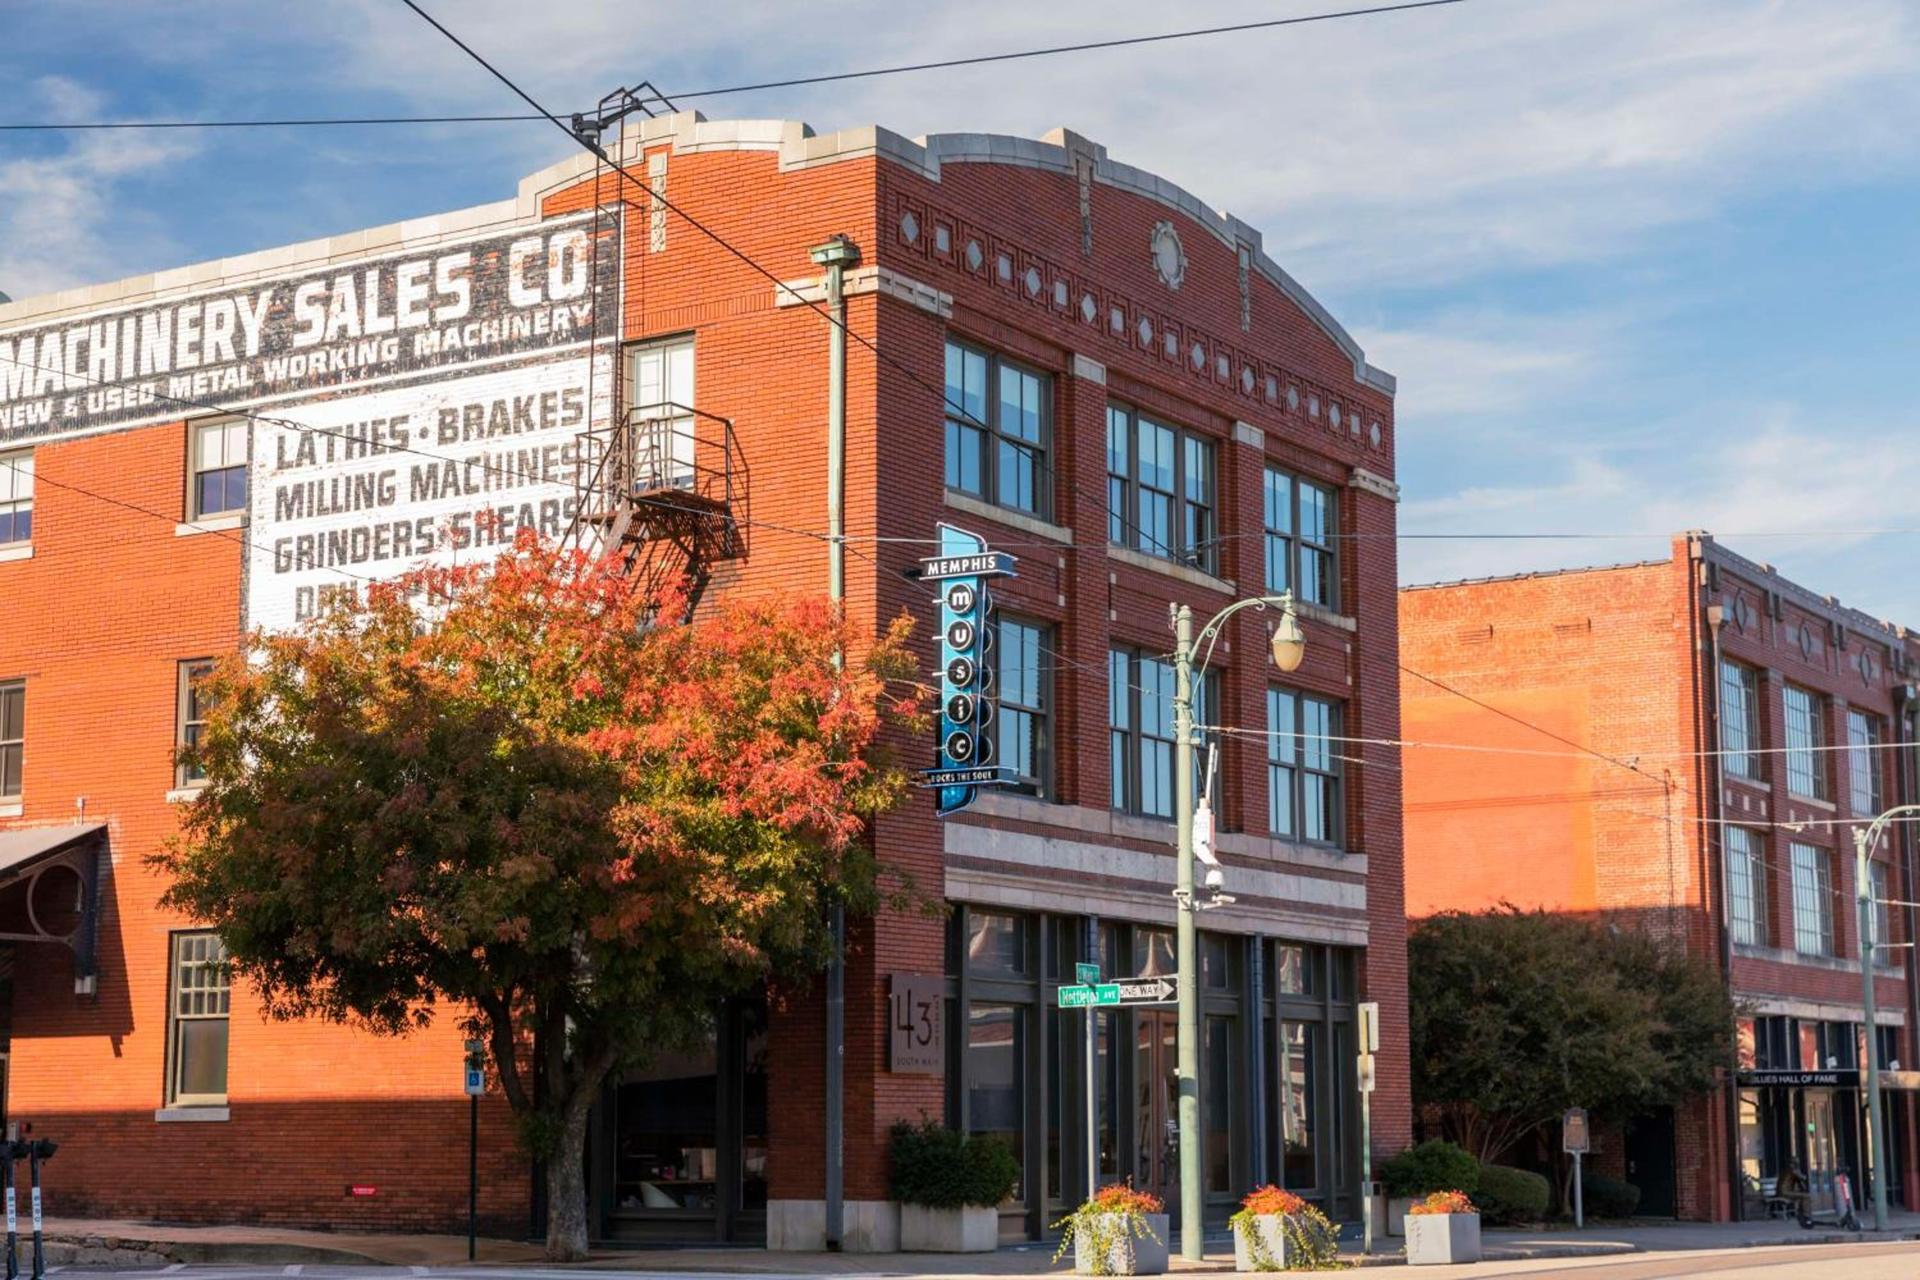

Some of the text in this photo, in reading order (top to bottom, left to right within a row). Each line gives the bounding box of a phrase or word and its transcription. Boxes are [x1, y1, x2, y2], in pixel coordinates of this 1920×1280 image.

[0, 290, 273, 399] MACHINERY
[293, 251, 472, 348] SALES
[0, 303, 593, 430] NEW & USED METAL WORKING MACHINERY
[276, 387, 585, 471] LATHES BRAKES
[275, 441, 580, 523] MILLING MACHINES
[274, 496, 579, 575] GRINDERS SHEARS
[928, 556, 996, 576] MEMPHIS
[957, 773, 970, 781] THE
[972, 771, 992, 780] SOUL
[897, 988, 932, 1050] 43
[1120, 983, 1159, 997] ONE WAY
[1779, 1075, 1800, 1083] HALL
[1801, 1075, 1812, 1083] OF
[1814, 1075, 1838, 1083] FAME
